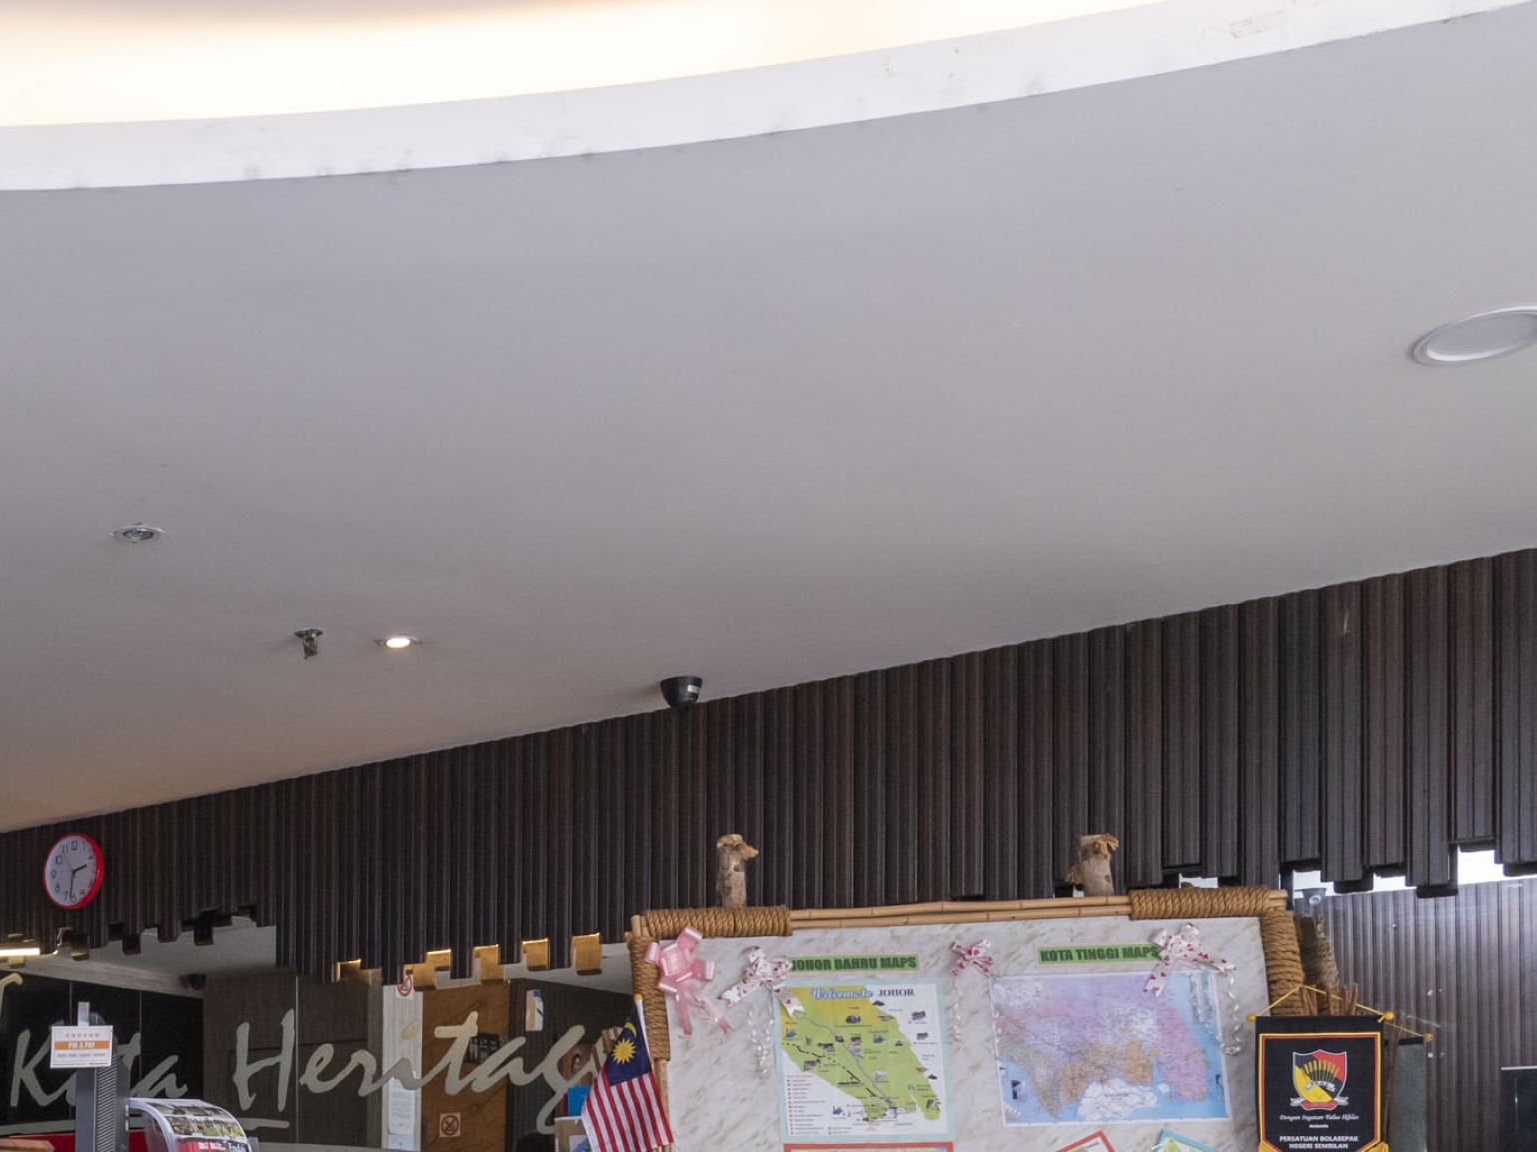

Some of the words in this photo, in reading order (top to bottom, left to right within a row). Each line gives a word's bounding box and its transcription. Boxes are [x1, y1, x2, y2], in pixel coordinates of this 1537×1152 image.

[1040, 949, 1074, 962] KOTA
[1075, 948, 1119, 961] TINGGI
[1122, 946, 1160, 958] MAPS
[791, 959, 831, 971] JOHOR
[834, 957, 877, 970] BAHRU
[881, 956, 916, 969] MAPS
[878, 988, 915, 998] JOHOR
[10, 1020, 189, 1108] Kta
